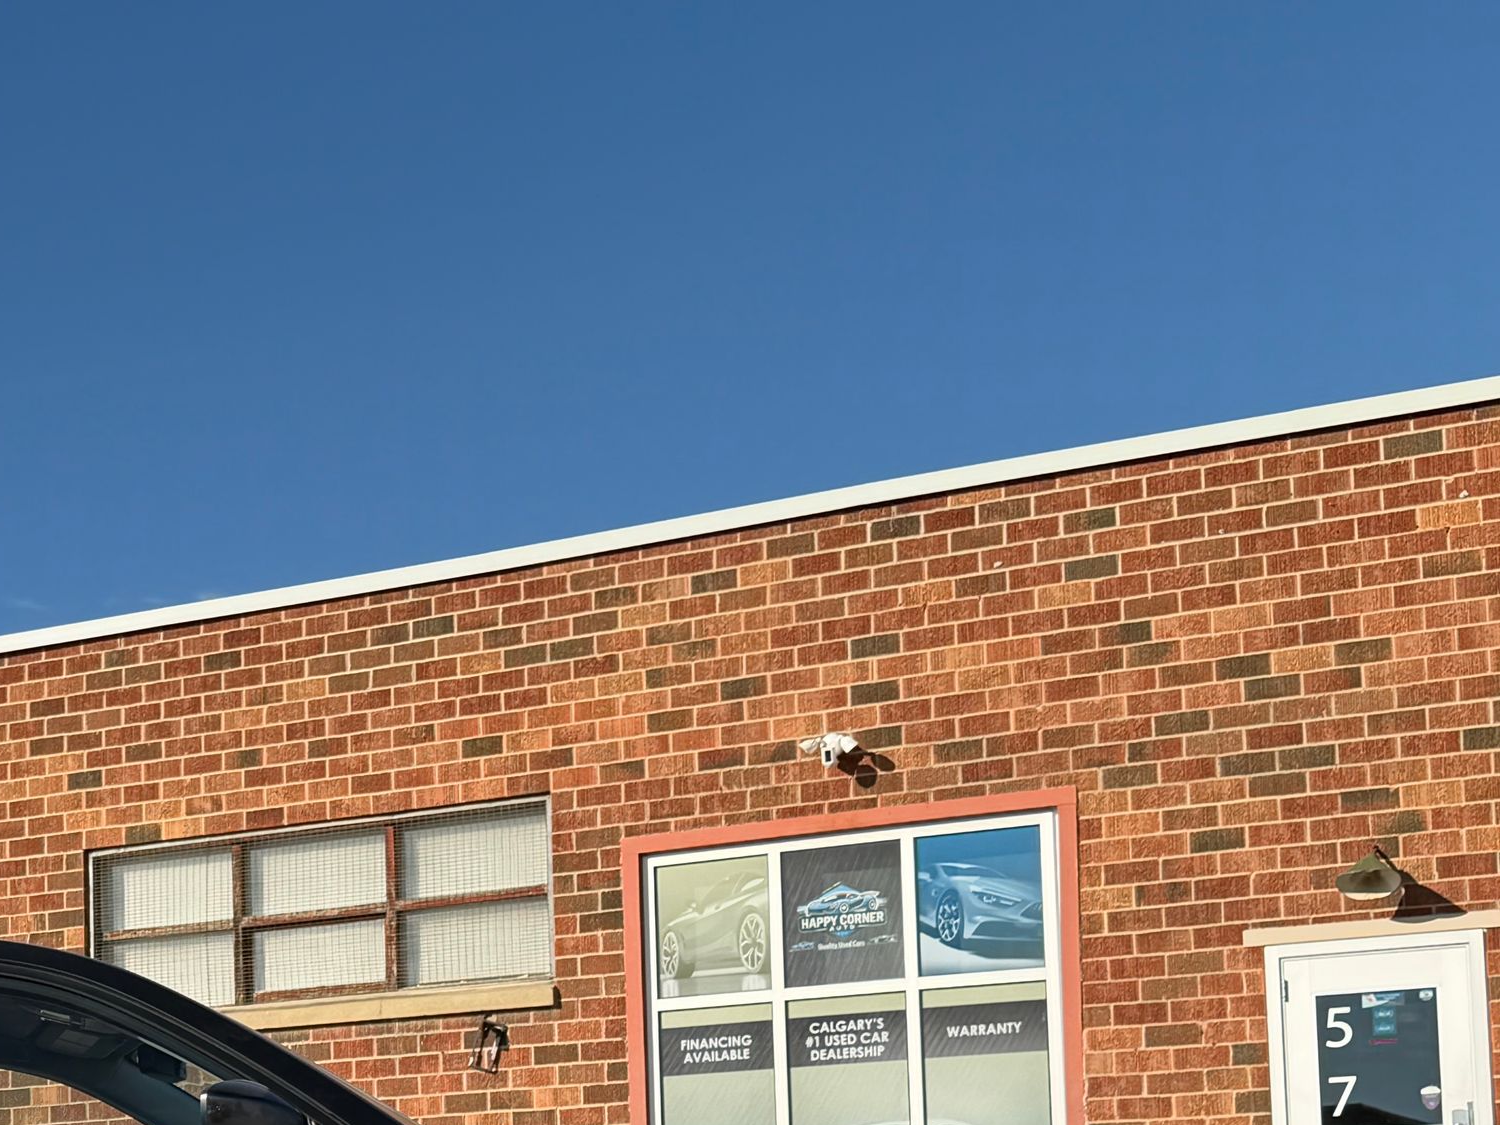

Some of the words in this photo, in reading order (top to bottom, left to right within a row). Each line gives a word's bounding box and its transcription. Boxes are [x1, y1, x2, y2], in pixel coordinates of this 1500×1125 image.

[801, 915, 838, 929] HAPPY
[839, 911, 884, 925] CORNER
[809, 1017, 885, 1034] CALGARY'S
[946, 1020, 1022, 1038] WARRANTY
[680, 1034, 753, 1051] FINANCING
[805, 1035, 820, 1048] #1
[824, 1033, 857, 1047] USED
[860, 1031, 889, 1044] CAR
[683, 1048, 751, 1064] AVAILABLE
[810, 1045, 885, 1061] DEALERSHIP
